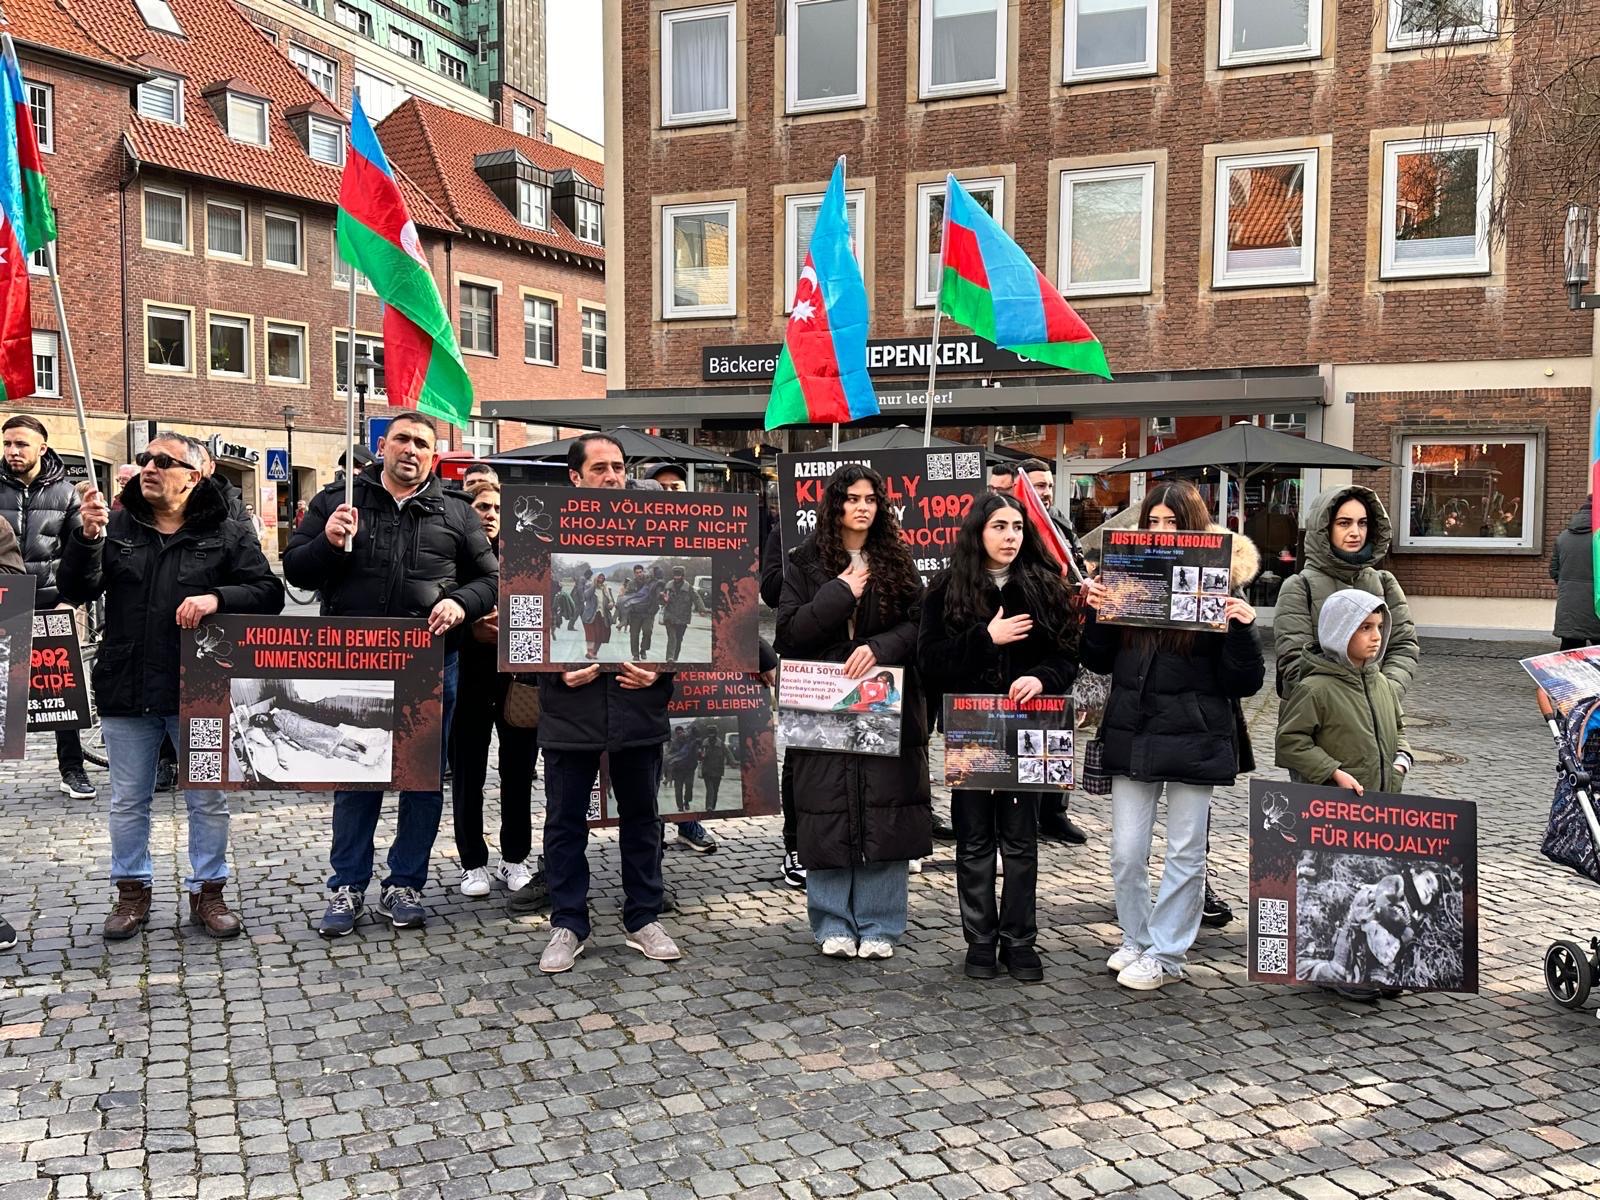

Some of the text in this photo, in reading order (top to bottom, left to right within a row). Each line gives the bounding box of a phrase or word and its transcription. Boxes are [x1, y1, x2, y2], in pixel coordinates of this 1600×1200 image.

[709, 355, 780, 374] Bäckerei
[878, 395, 902, 405] nur
[560, 498, 748, 517] „DER VÖLKERMORD IN
[560, 516, 748, 534] KHOJALY DARF NICHT
[560, 533, 665, 549] UNGESTRAFT
[1110, 531, 1224, 548] JUSTICE FOR KHOJALY
[238, 627, 313, 647] „KHOJALY:
[404, 627, 431, 648] FÜR
[31, 648, 70, 669] 992
[683, 684, 762, 696] DARF NICHT
[42, 697, 66, 709] 1275
[953, 697, 995, 710] JUSTICE
[1301, 799, 1458, 831] „GERECHTIGKEIT
[1310, 824, 1348, 847] FÜR
